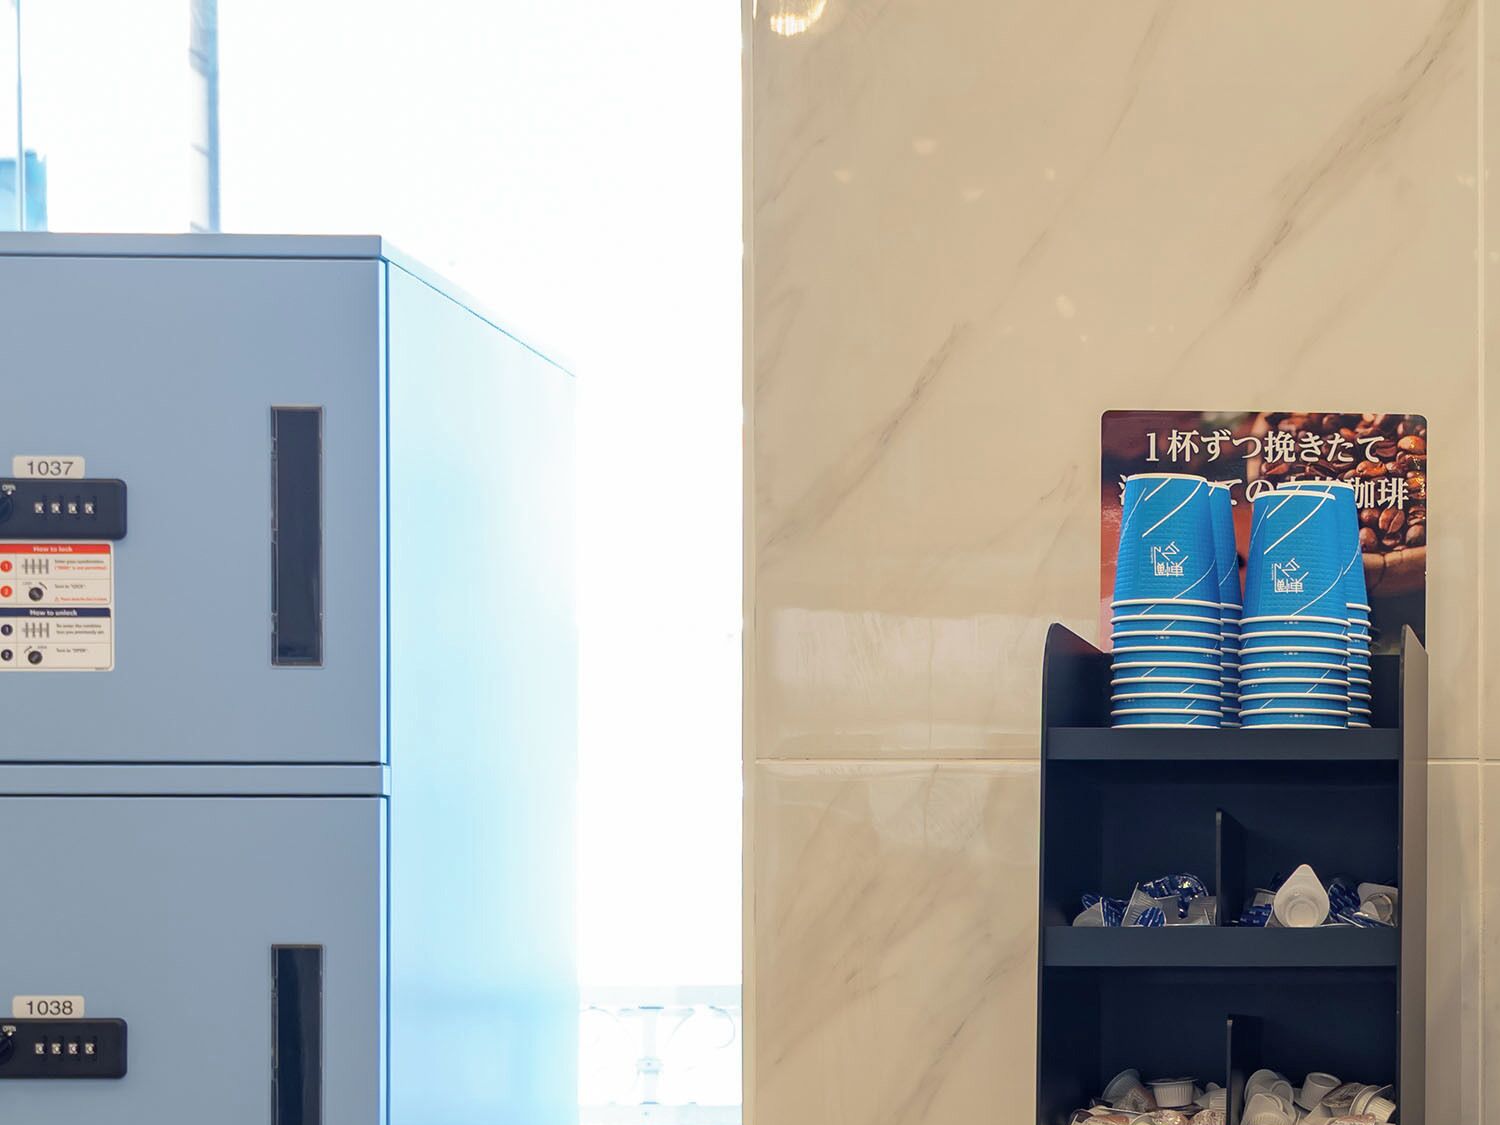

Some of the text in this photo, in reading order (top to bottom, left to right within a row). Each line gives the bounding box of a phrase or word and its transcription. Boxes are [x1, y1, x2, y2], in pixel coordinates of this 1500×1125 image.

[1146, 429, 1385, 463] 1杯ずつ挽きたて
[26, 461, 74, 476] 1037
[26, 1000, 73, 1016] 1038
